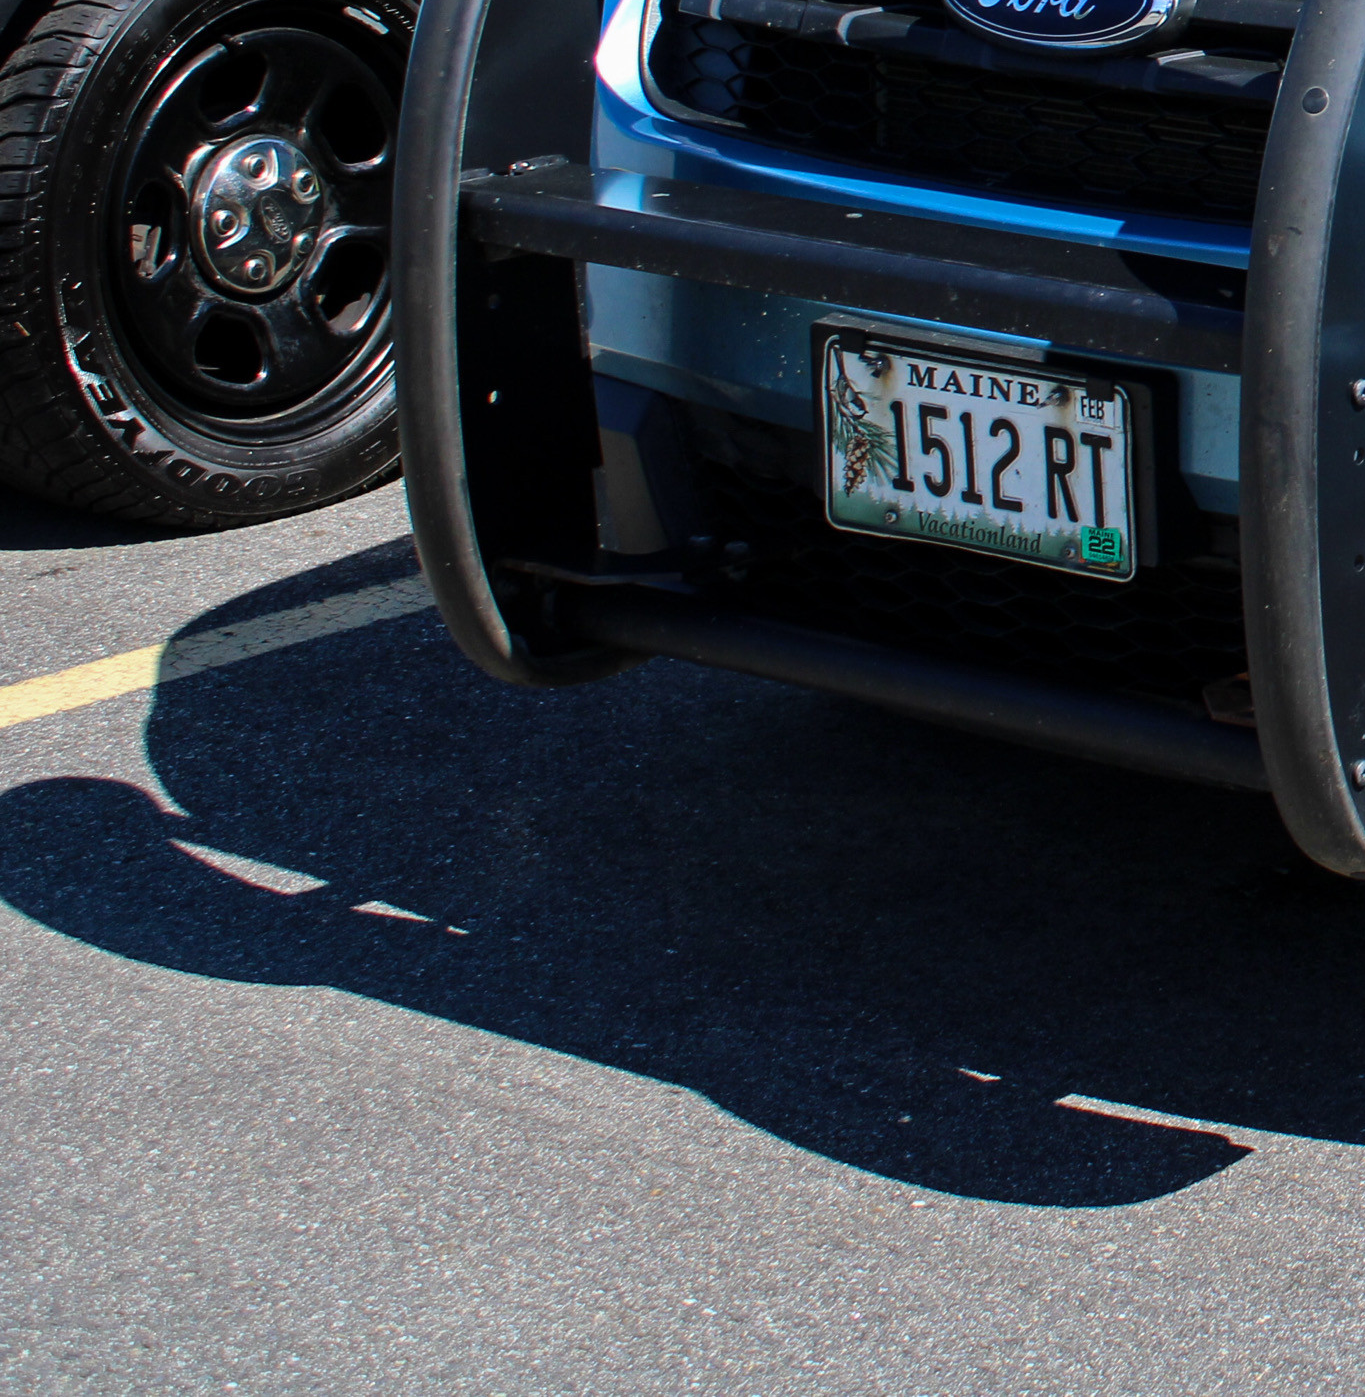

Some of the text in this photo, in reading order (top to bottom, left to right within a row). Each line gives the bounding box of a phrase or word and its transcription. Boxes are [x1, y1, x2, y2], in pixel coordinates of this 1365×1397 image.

[60, 276, 321, 500] GOODYEAR
[907, 363, 1040, 407] MAINE
[1081, 395, 1105, 420] FEB
[890, 400, 1112, 530] 1512 RT
[918, 511, 1041, 554] Vacationland
[1088, 528, 1115, 540] MAINE
[1088, 535, 1116, 555] 22
